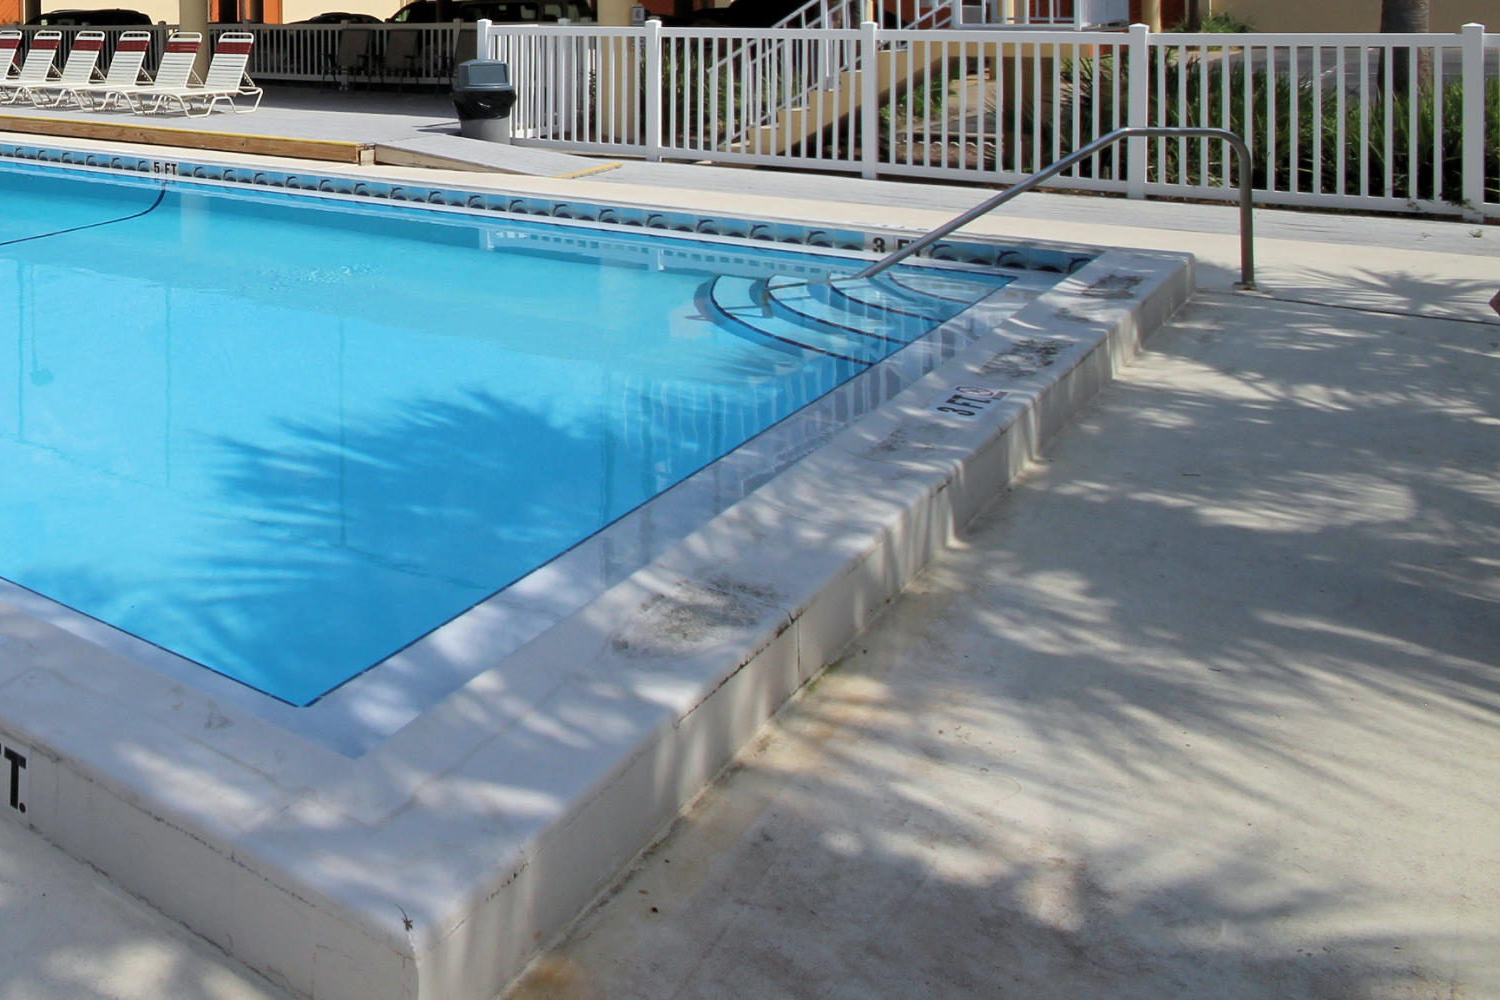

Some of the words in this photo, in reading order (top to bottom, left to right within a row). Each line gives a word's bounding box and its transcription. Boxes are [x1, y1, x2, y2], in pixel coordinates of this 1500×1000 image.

[154, 161, 160, 174] 5
[165, 162, 177, 175] FT
[872, 237, 886, 253] 3
[936, 406, 976, 416] 3
